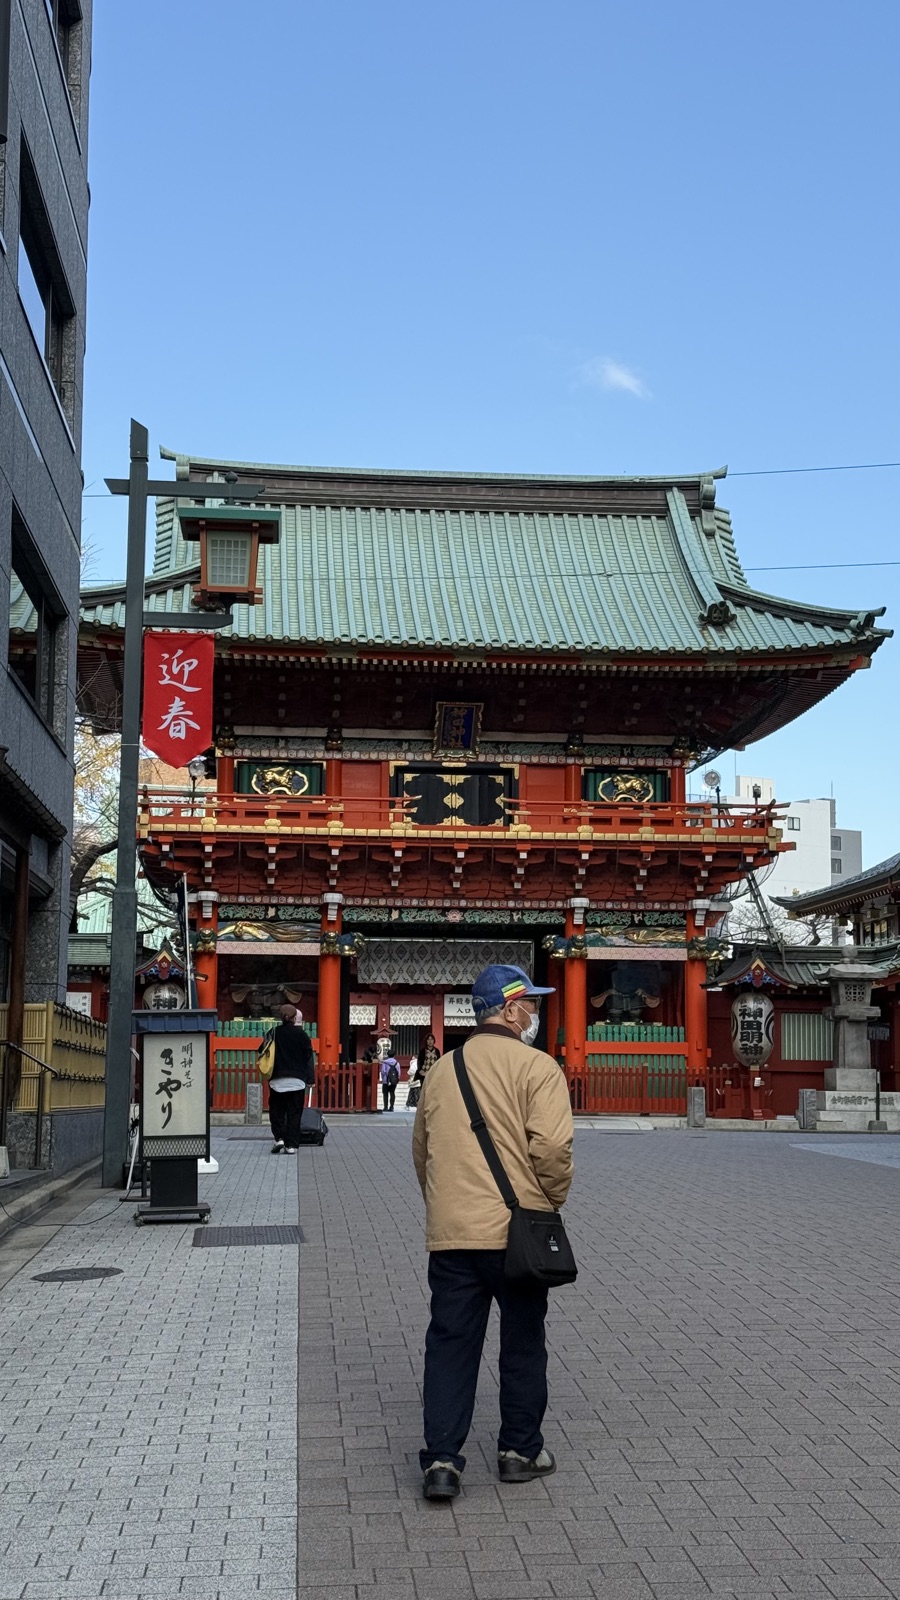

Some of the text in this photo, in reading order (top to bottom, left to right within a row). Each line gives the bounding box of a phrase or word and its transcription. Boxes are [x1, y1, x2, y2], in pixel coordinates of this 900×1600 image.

[157, 649, 203, 740] 迎春
[738, 1005, 764, 1056] 神田明神
[155, 1048, 182, 1130] きやり
[180, 1042, 195, 1088] 明神そば
